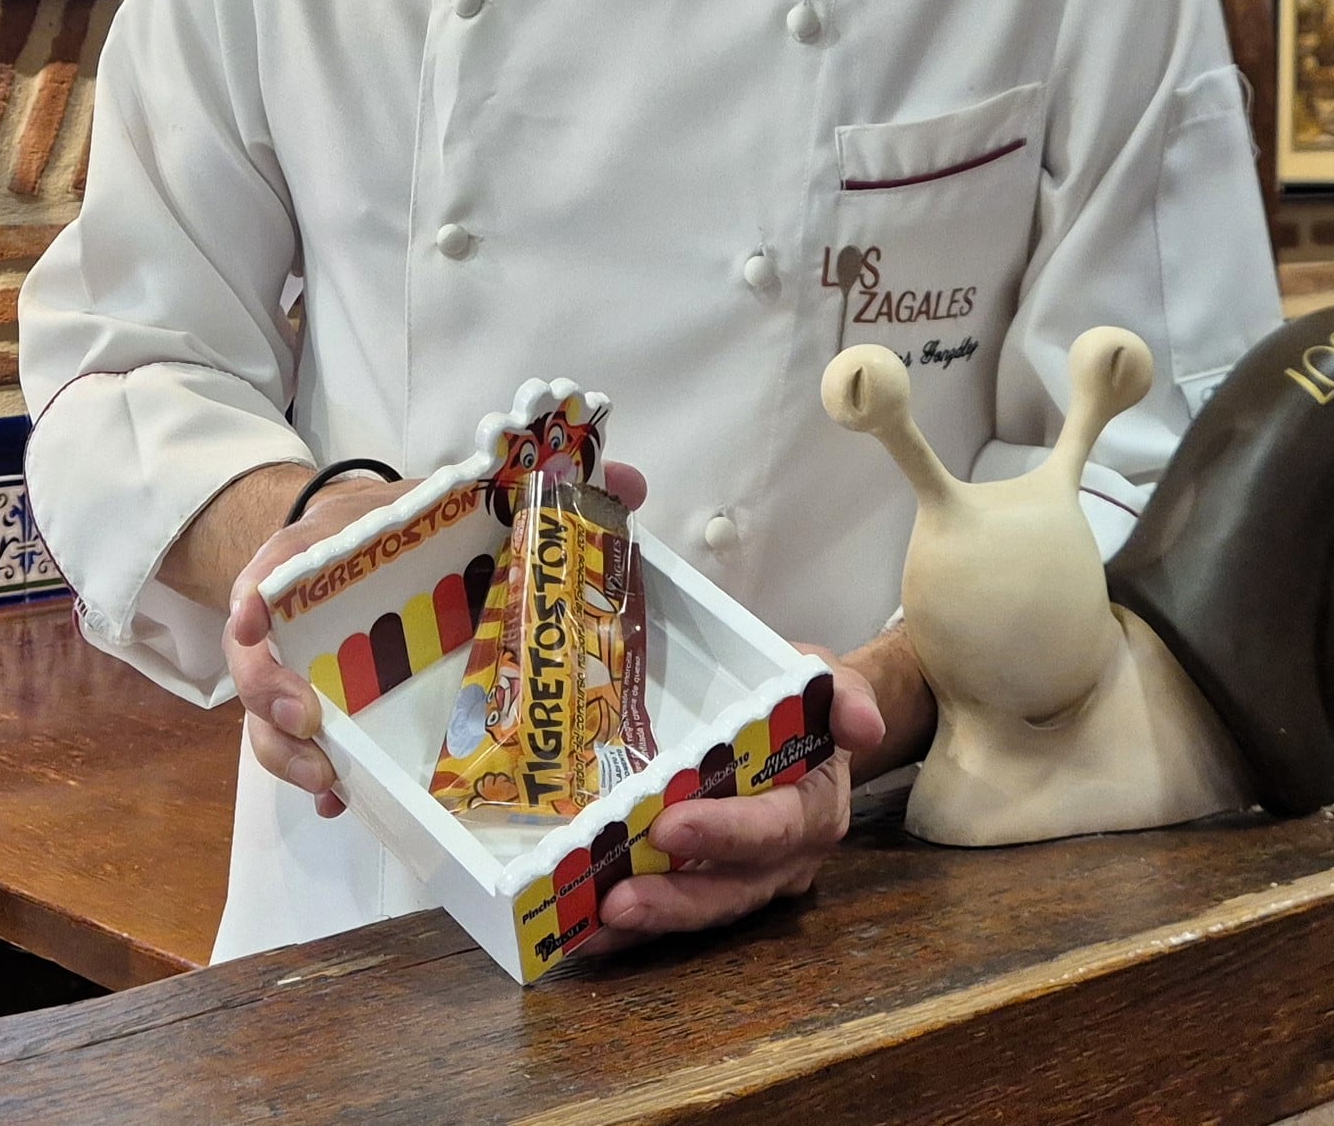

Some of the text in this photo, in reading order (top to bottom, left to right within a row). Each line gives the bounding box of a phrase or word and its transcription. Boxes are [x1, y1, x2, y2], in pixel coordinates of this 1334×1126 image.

[821, 245, 882, 290] LOS
[853, 286, 977, 323] ZAGALES
[273, 484, 479, 620] TIGRETOSTÓN
[612, 538, 623, 587] ZAGALES
[523, 513, 569, 808] TIGRETOSTÓN
[575, 672, 586, 731] concurso
[572, 731, 584, 754] del
[574, 755, 586, 808] Ganador
[522, 894, 557, 925] Pincho
[559, 863, 604, 897] Ganador
[621, 828, 650, 852] Conc
